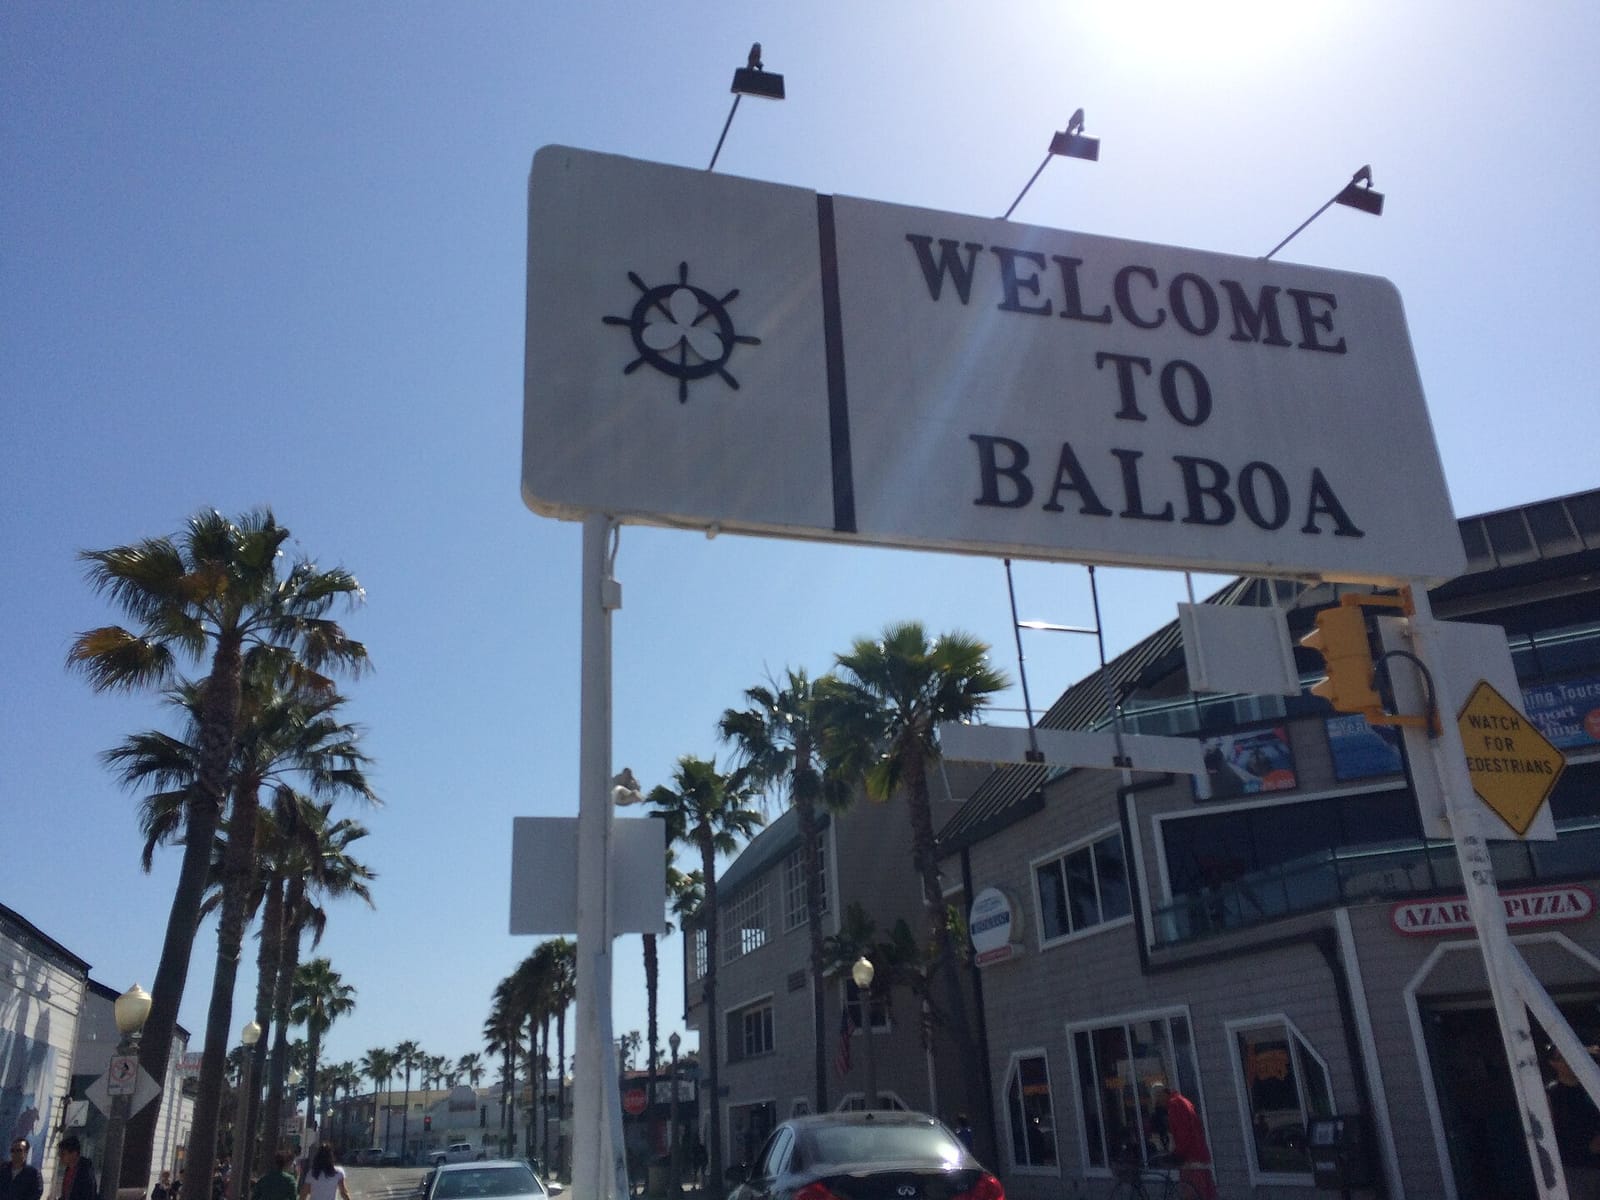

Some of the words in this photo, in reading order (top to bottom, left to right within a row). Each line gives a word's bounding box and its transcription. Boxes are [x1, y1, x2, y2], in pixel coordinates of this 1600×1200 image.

[905, 233, 1347, 354] WELCOME
[1095, 351, 1213, 427] TO
[968, 433, 1366, 538] BALBOA
[1468, 714, 1520, 731] WATCH
[1484, 735, 1515, 752] FOR
[1466, 757, 1553, 775] EDESTRIANS
[1404, 904, 1470, 927] AZAR
[1503, 893, 1583, 917] PIZZA
